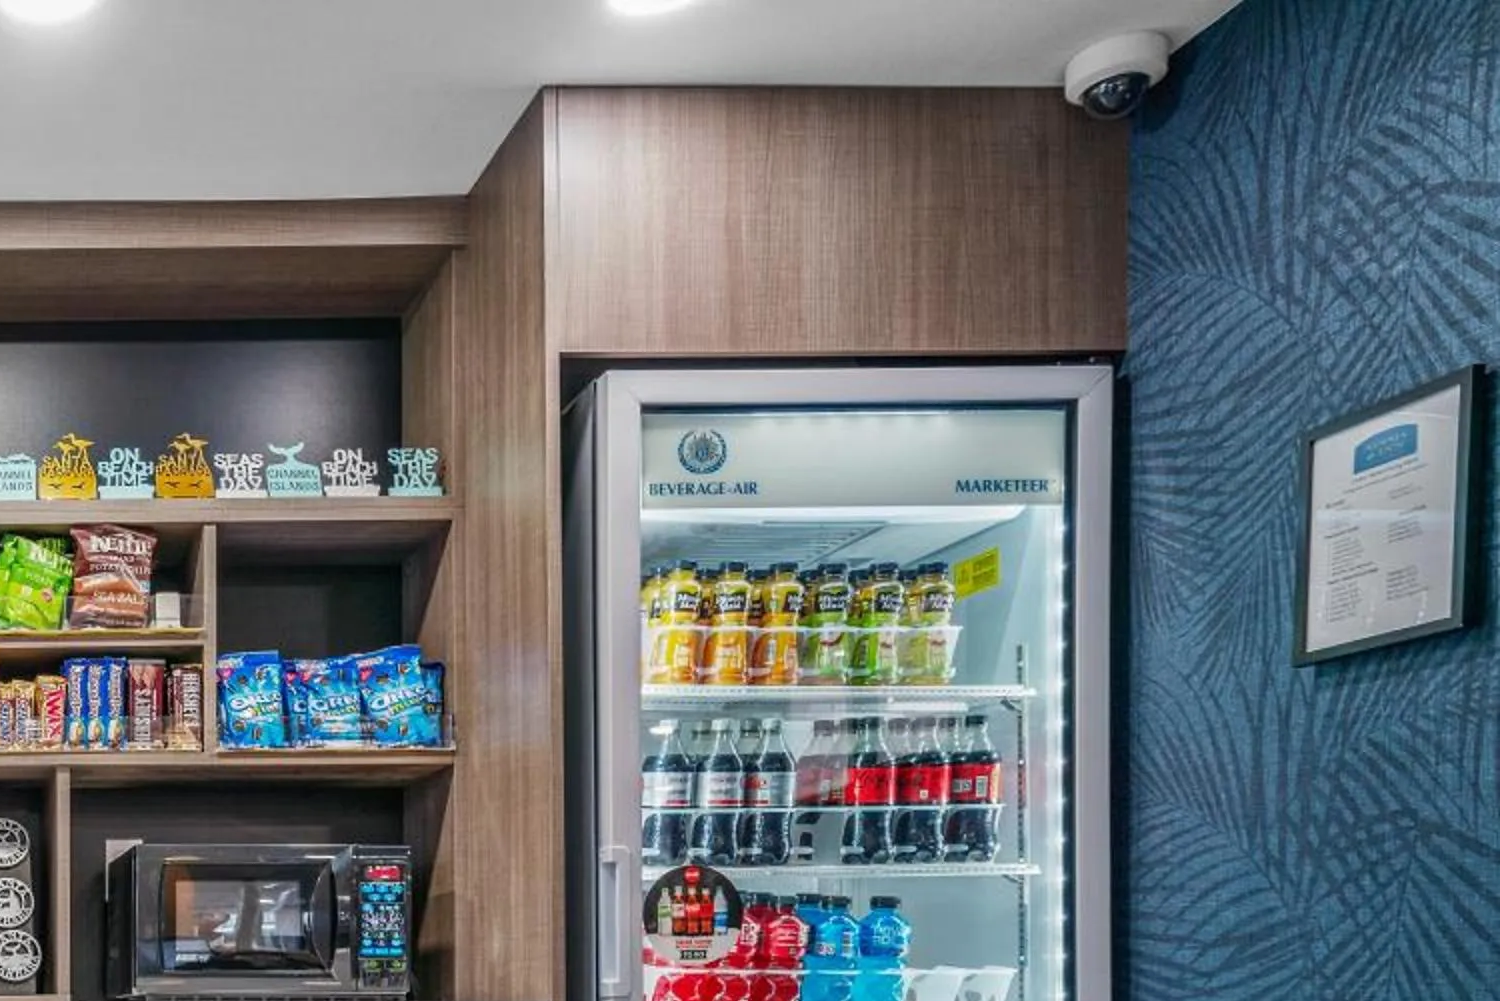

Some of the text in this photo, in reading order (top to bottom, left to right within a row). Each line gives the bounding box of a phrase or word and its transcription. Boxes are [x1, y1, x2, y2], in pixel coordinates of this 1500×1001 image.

[42, 456, 91, 467] SANTA
[110, 448, 139, 462] ON
[158, 455, 207, 467] SANTA
[214, 454, 264, 467] SEAS
[334, 448, 363, 462] ON
[388, 448, 439, 462] SEAS
[98, 462, 153, 475] BEACH
[224, 466, 260, 478] THE
[268, 469, 319, 479] CHANNEL
[323, 462, 377, 475] BEACH
[397, 462, 433, 475] THE
[106, 473, 148, 486] TIME
[220, 478, 262, 490] DAY
[270, 481, 319, 491] ISLANDS
[330, 473, 373, 487] TIME
[394, 475, 435, 488] DAY
[955, 479, 1049, 492] MARKETEER
[648, 482, 758, 496] BEVERAGE-AIR
[230, 692, 282, 710] OREO
[45, 687, 66, 738] TWIX
